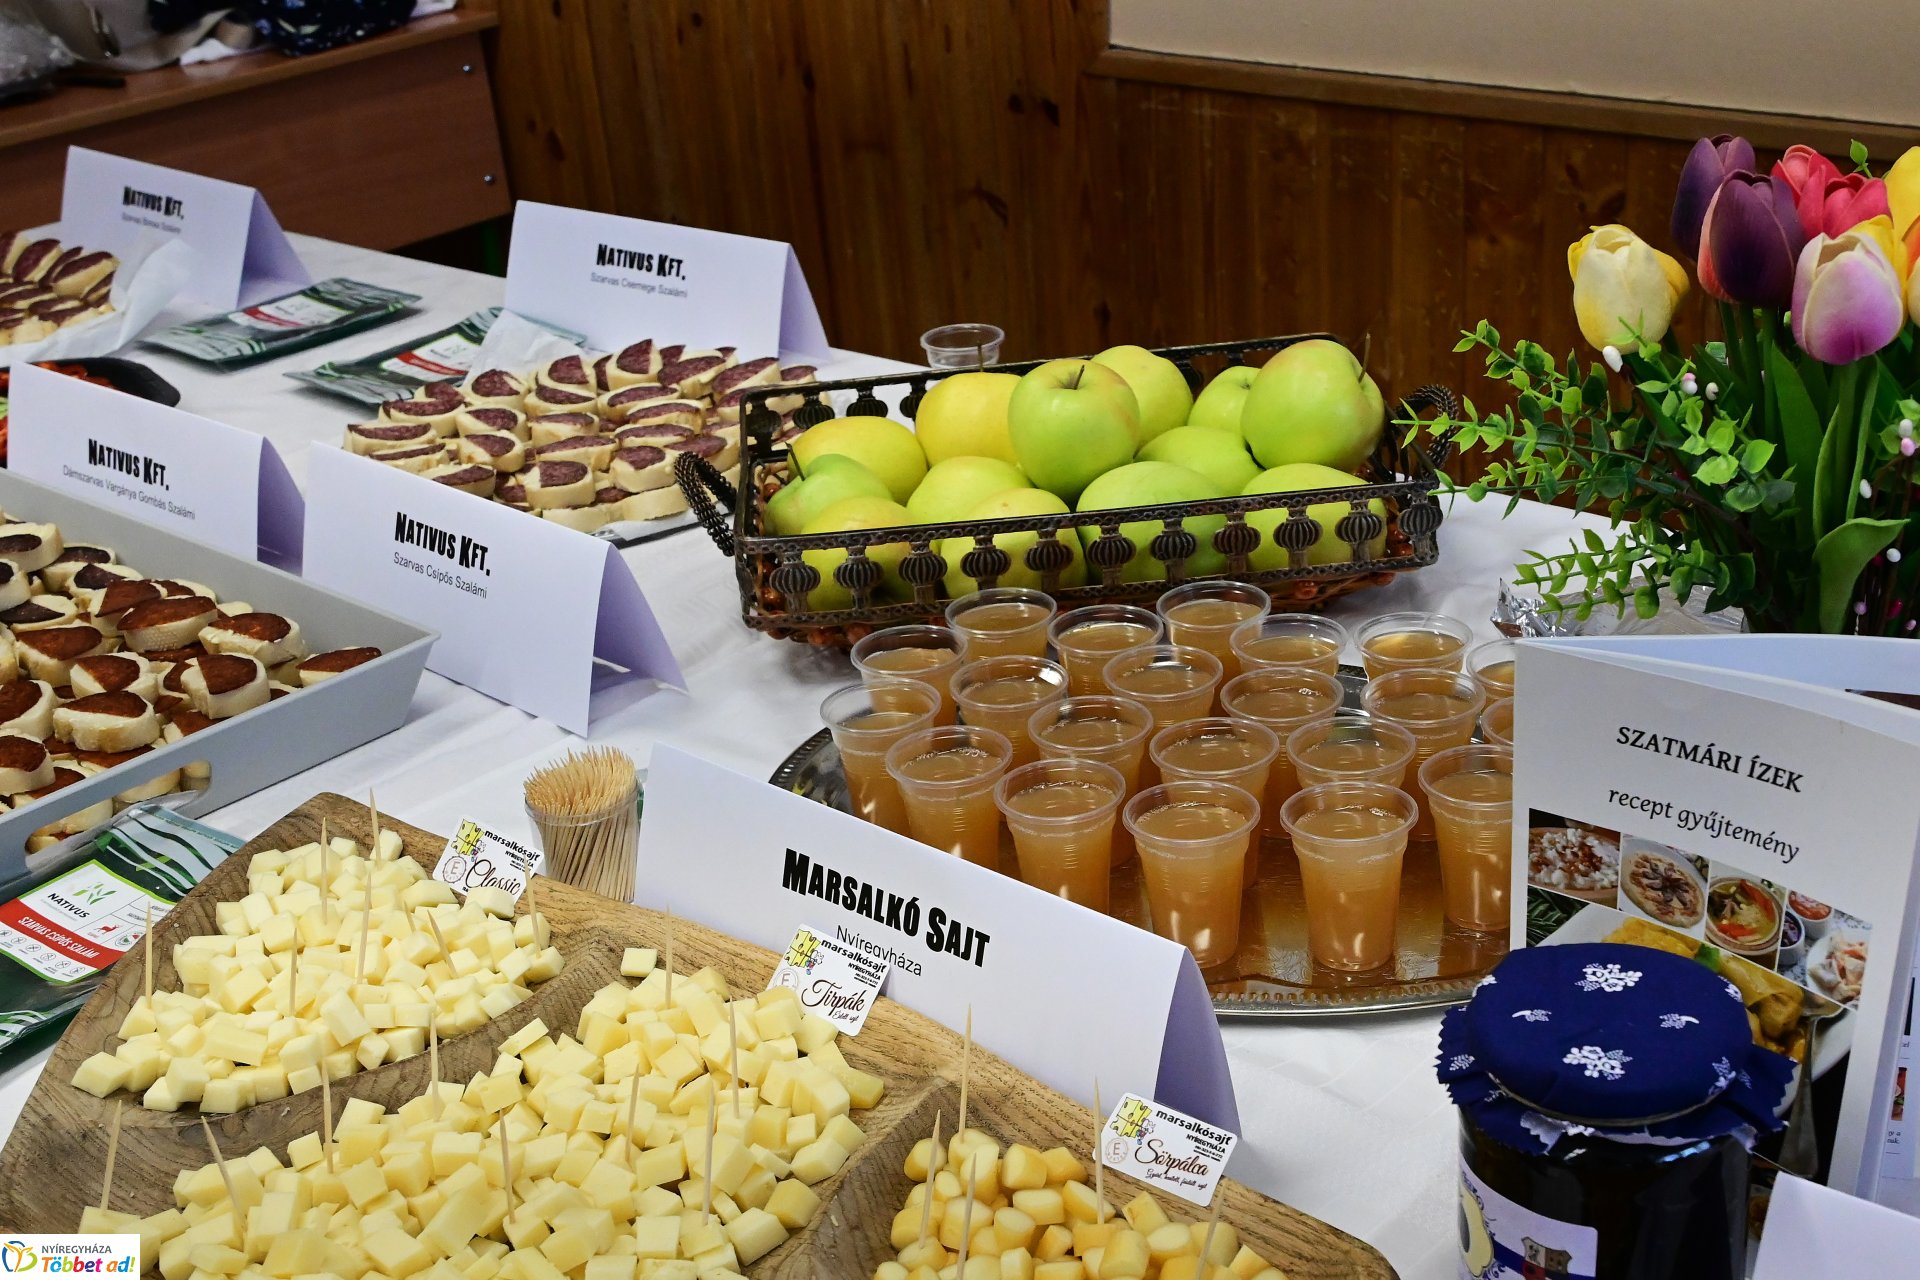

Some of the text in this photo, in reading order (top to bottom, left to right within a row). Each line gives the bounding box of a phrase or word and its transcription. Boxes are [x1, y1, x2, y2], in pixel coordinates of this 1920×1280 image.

[393, 551, 424, 575] Szarvas
[455, 575, 488, 600] Szalámi
[1616, 726, 1804, 793] SZATMÁRI ÍZEK
[1608, 789, 1800, 864] recept gyűjtemény
[465, 858, 521, 897] Classic
[47, 892, 90, 918] NATIVUS
[801, 979, 867, 1016] Tirpák
[1134, 1138, 1209, 1176] Sörpálca
